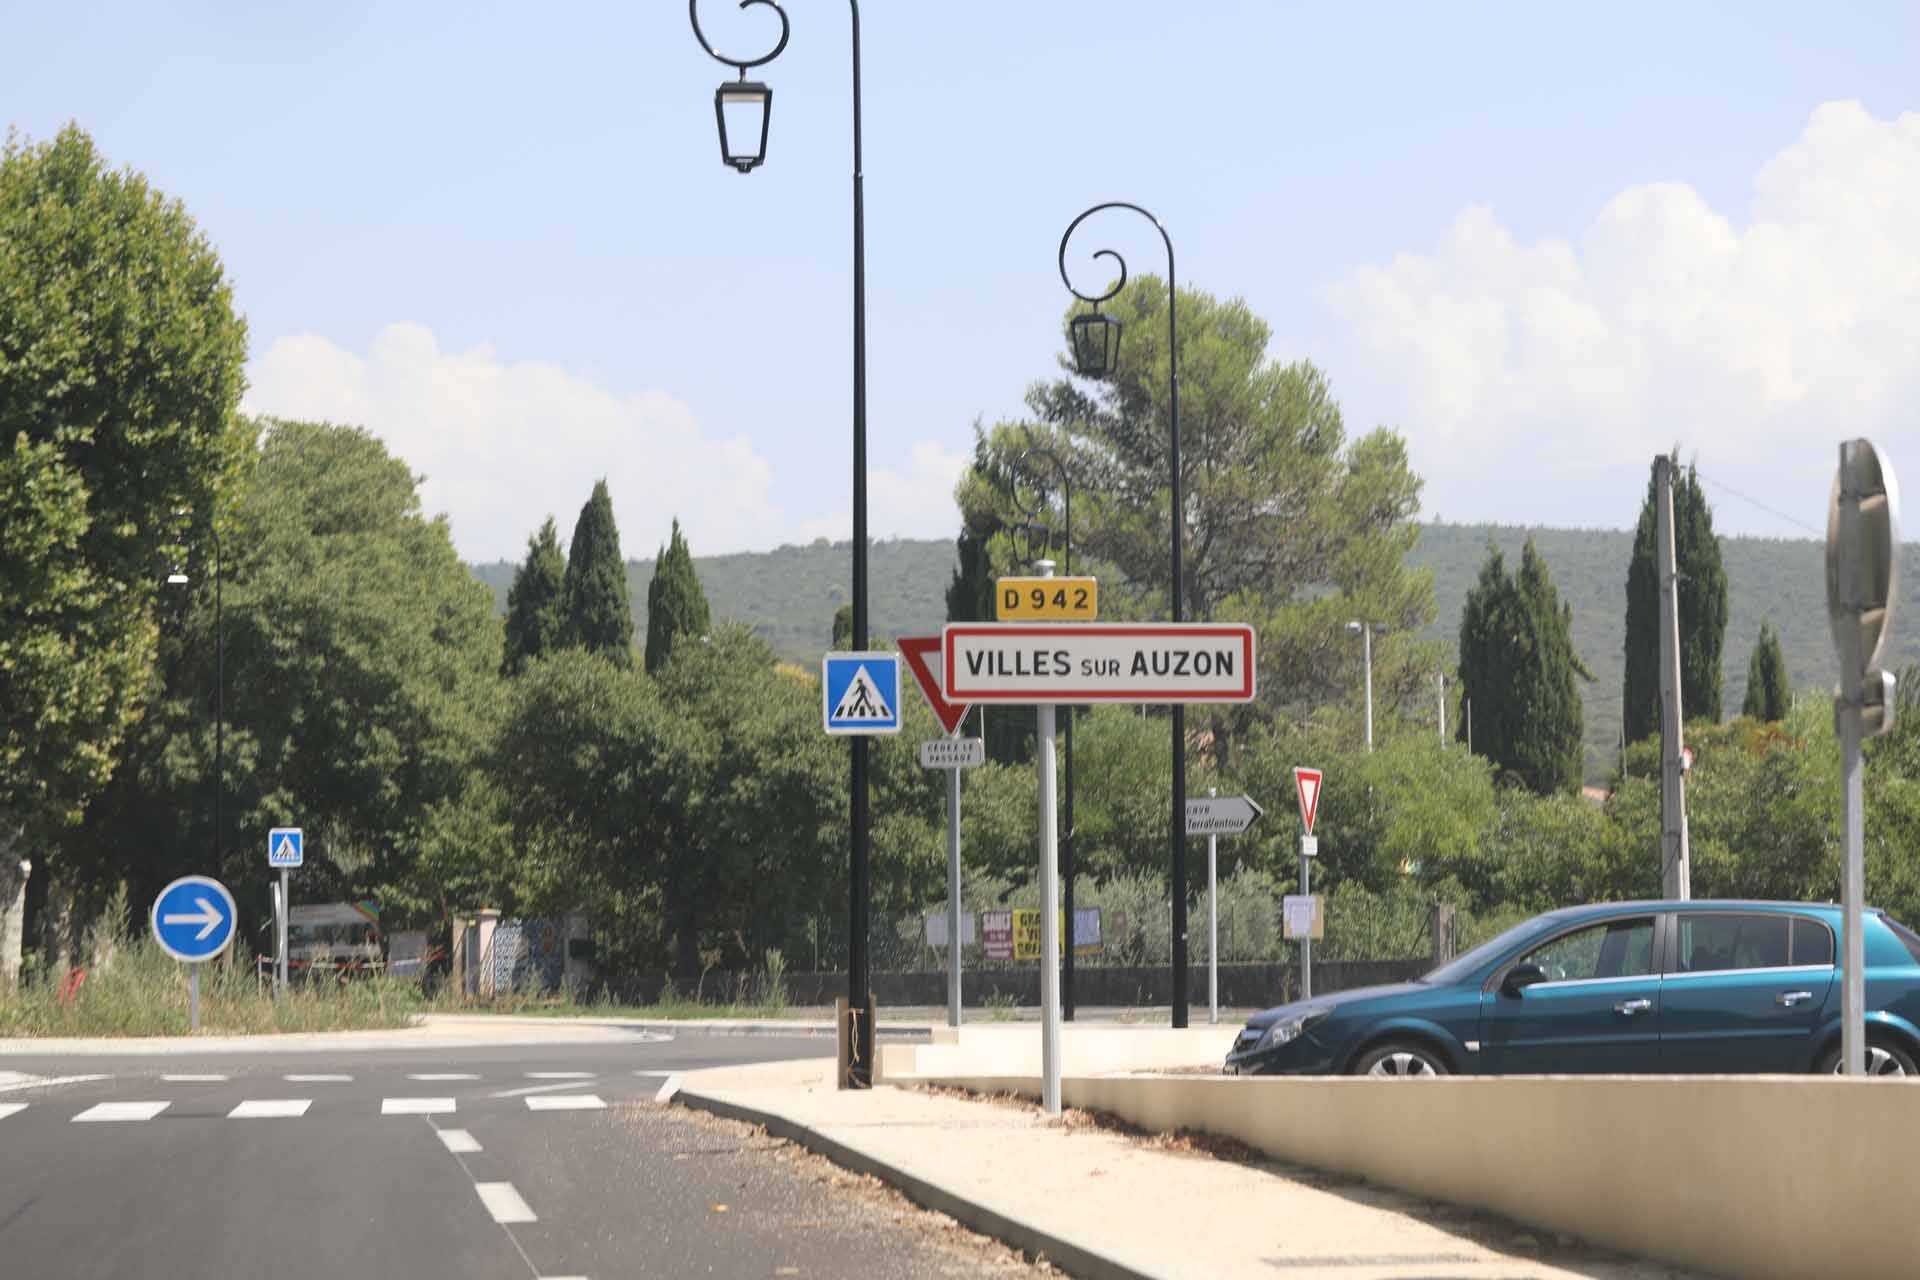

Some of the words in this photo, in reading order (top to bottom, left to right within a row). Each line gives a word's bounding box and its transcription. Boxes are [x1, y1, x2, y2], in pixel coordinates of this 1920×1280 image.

[1004, 589, 1019, 609] D
[1031, 589, 1089, 609] 942
[965, 650, 1071, 676] VILLES
[1081, 659, 1120, 676] SUR
[1130, 651, 1234, 676] AUZON
